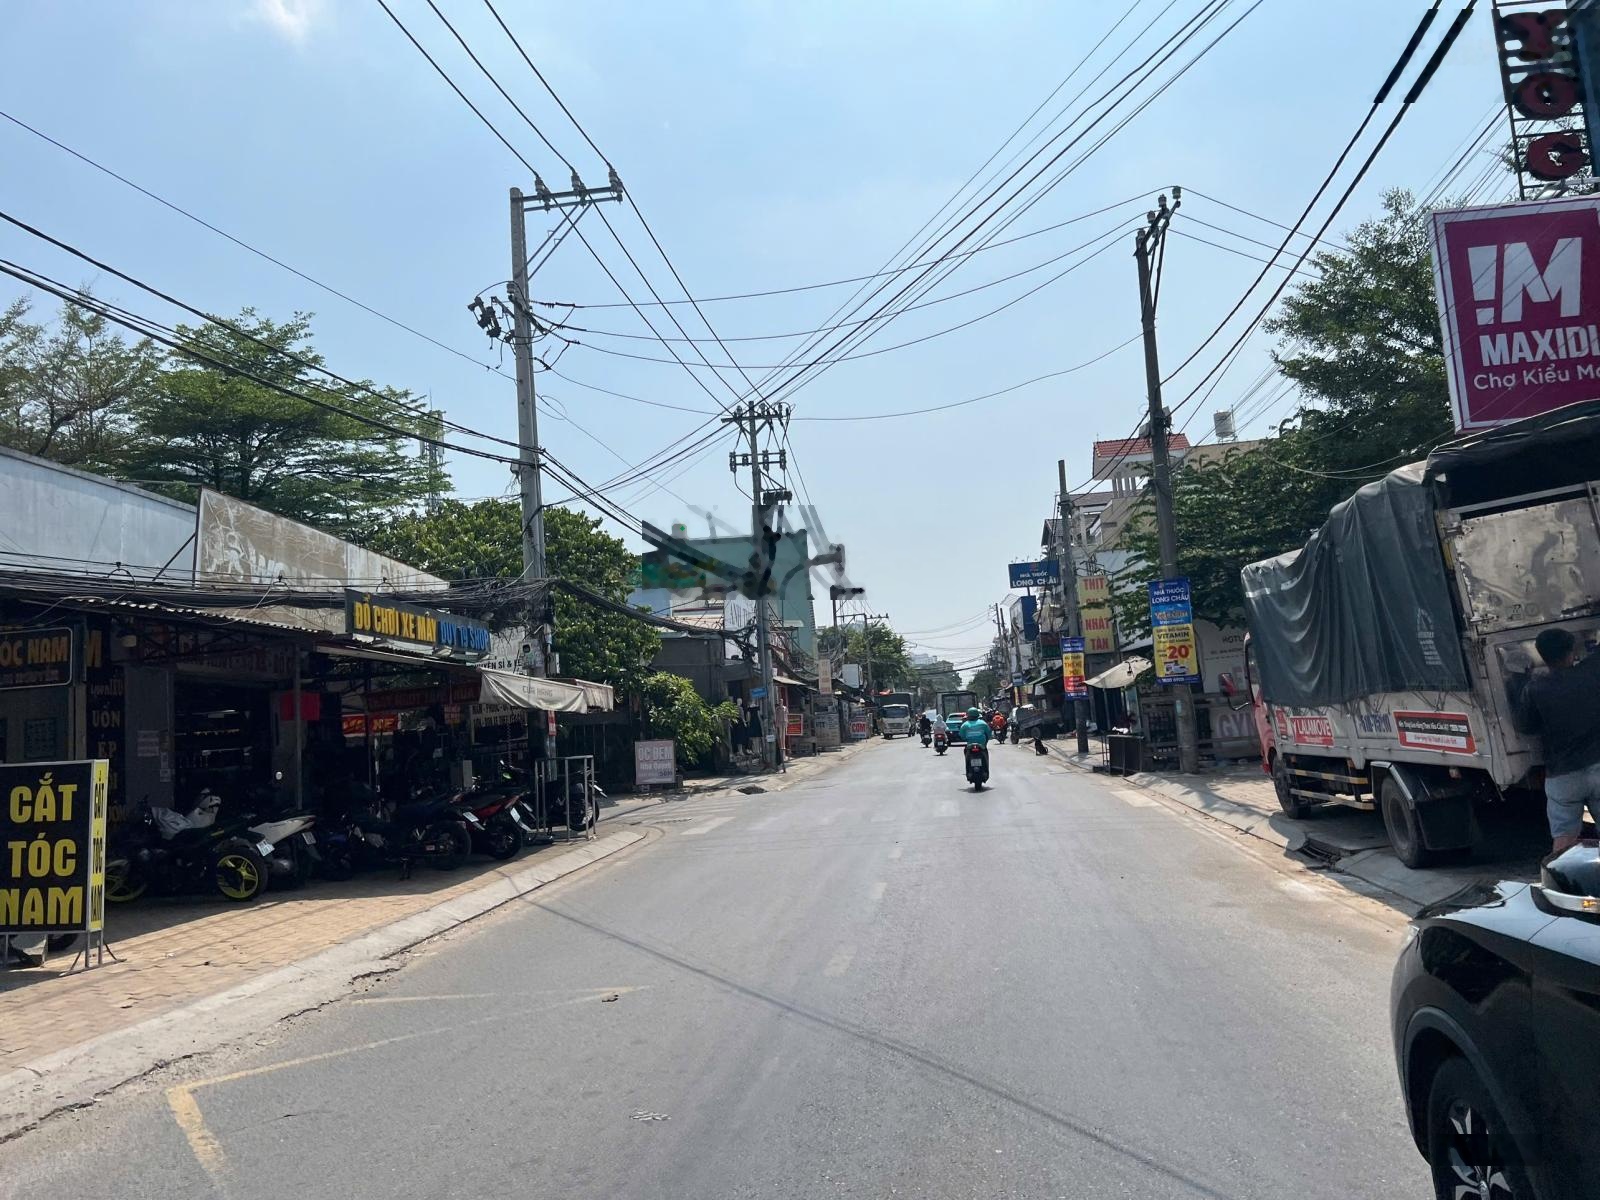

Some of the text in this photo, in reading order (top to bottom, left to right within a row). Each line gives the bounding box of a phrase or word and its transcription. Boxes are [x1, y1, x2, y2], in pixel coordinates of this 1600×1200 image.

[1474, 373, 1516, 391] Chợ
[1523, 364, 1570, 386] Kiểu
[1012, 578, 1034, 587] LONG
[1151, 595, 1170, 604] LONG
[401, 612, 416, 639] XE
[416, 611, 438, 643] MÁY
[1157, 631, 1190, 640] VITAMIN
[27, 636, 68, 665] NAM
[1297, 719, 1332, 736] LALAMOVE
[10, 772, 78, 823] CẮT
[8, 832, 76, 878] TÓC
[0, 886, 83, 926] NAM
